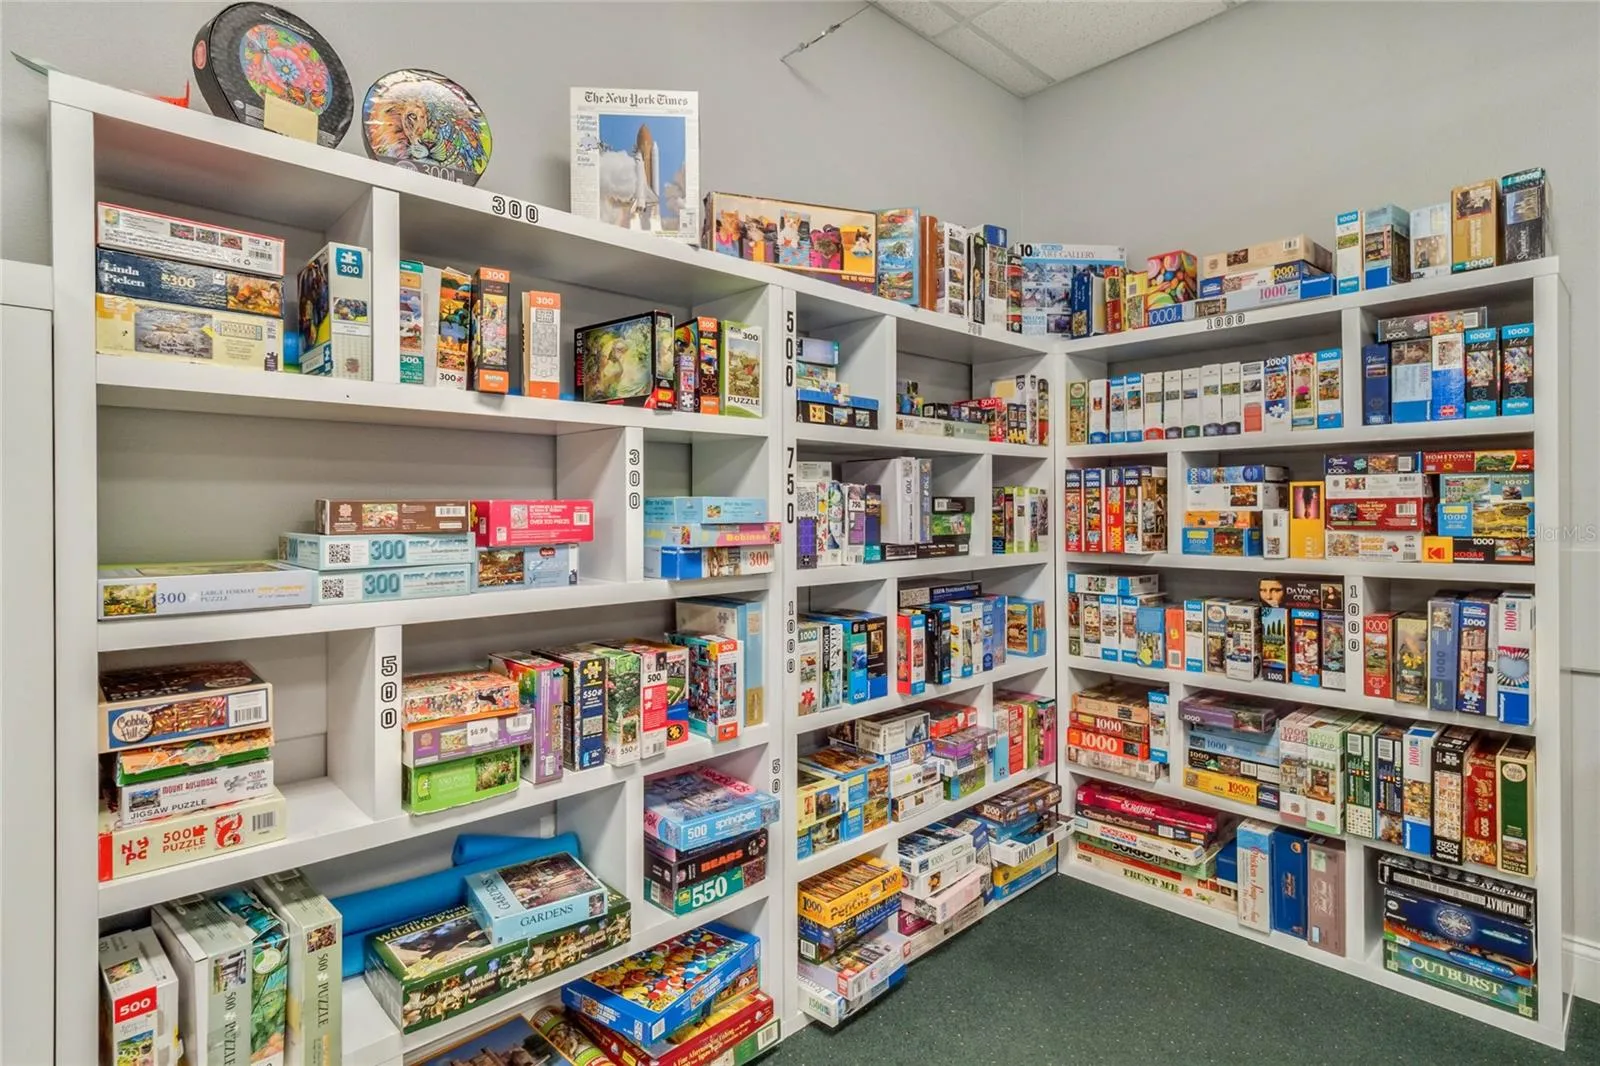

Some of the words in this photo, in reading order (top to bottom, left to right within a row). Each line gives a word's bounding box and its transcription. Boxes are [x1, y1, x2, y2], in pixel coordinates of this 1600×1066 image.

[584, 91, 604, 104] The
[605, 92, 628, 104] New
[630, 92, 655, 107] York
[656, 94, 688, 107] Times
[492, 196, 538, 223] 300
[1338, 213, 1357, 223] 1000
[104, 262, 140, 277] Linda
[341, 264, 359, 275] 300
[487, 271, 505, 280] 300
[104, 274, 145, 288] Picken
[1260, 285, 1286, 300] 1000
[535, 297, 553, 305] 300
[1206, 312, 1245, 329] 1000
[742, 332, 758, 341] 300
[1508, 328, 1529, 336] 1000
[786, 311, 794, 387] 500
[439, 373, 457, 382] 300
[728, 396, 760, 406] PUZZLE
[981, 398, 995, 407] 500
[1425, 453, 1472, 461] HOMETOWN
[629, 449, 640, 509] 300
[371, 540, 406, 562] 300
[750, 552, 768, 566] 300
[1453, 551, 1485, 559] KODAK
[364, 573, 400, 595] 300
[157, 592, 186, 604] 300
[1348, 585, 1359, 651] 1000
[1365, 620, 1388, 632] 1000
[1463, 618, 1486, 627] 1000
[1504, 610, 1517, 631] 1000
[787, 601, 795, 673] 1000
[800, 630, 816, 640] 1000
[721, 643, 734, 652] 300
[1436, 650, 1446, 677] 1000
[647, 673, 661, 682] 500
[1267, 671, 1283, 680] 1000
[381, 656, 397, 729] 500
[1096, 717, 1121, 733] 1000
[1283, 726, 1307, 736] 1000
[1081, 732, 1118, 753] 1000
[1207, 739, 1227, 751] 1000
[1189, 750, 1209, 760] 1000
[1409, 747, 1420, 766] 1000
[772, 759, 780, 793] 50
[162, 783, 184, 795] MOUNT
[1228, 781, 1250, 793] 1000
[130, 806, 168, 820] JIGSAW
[171, 799, 207, 813] PUZZLE
[715, 811, 757, 830] springbok
[163, 831, 191, 845] 500
[688, 825, 707, 840] 500
[163, 837, 206, 853] PUZZLE
[1436, 845, 1458, 856] 1000
[126, 850, 147, 866] PC
[701, 850, 743, 872] BEARS
[1018, 843, 1036, 864] 1000
[881, 873, 898, 892] 1000
[1123, 868, 1158, 887] TRUST
[1161, 880, 1179, 894] ME
[692, 877, 727, 908] 550
[802, 897, 823, 914] 1000
[1486, 896, 1525, 918] DIPLOMAT
[520, 903, 573, 928] GARDENS
[376, 917, 435, 942] Wildlife
[435, 907, 473, 923] Puzz
[318, 952, 328, 972] 500
[1412, 956, 1502, 995] OUTBURST
[120, 998, 151, 1016] 500
[224, 991, 236, 1011] 500
[318, 982, 329, 1028] PUZZLE
[223, 1020, 236, 1066] PUZZLE
